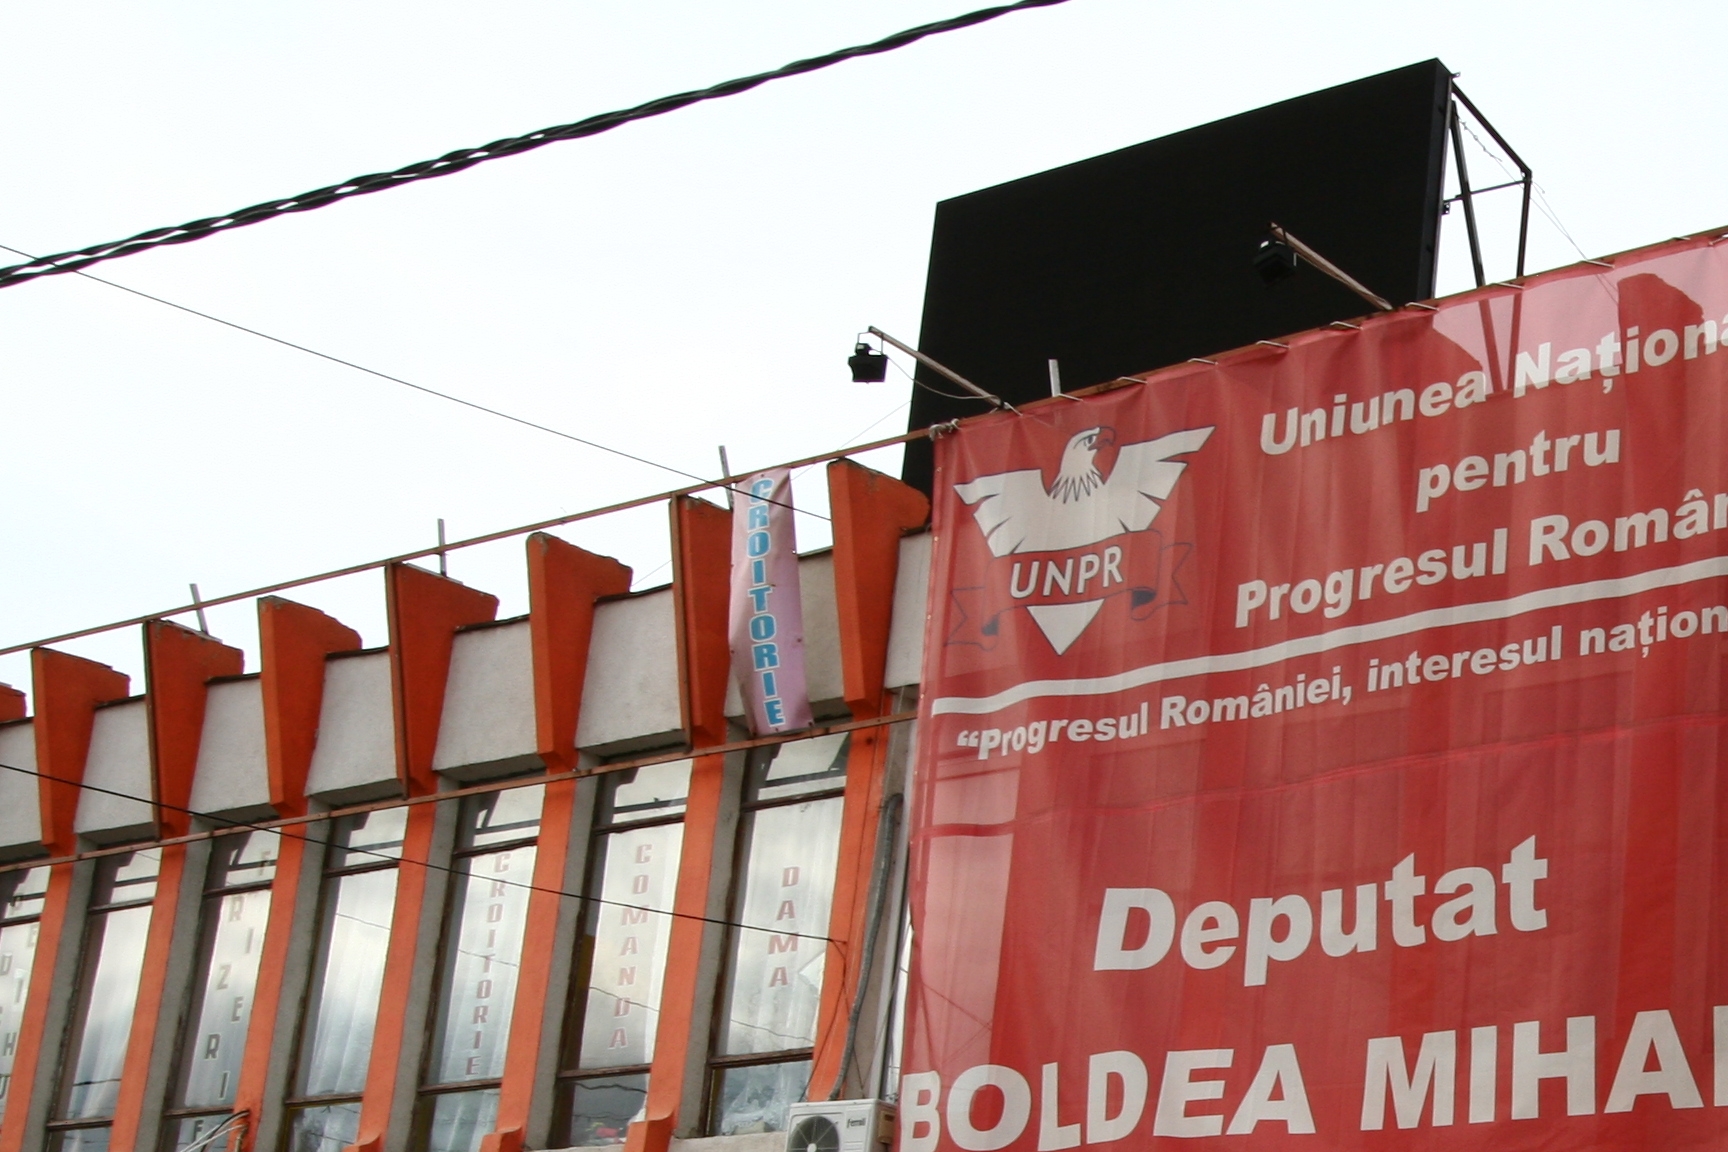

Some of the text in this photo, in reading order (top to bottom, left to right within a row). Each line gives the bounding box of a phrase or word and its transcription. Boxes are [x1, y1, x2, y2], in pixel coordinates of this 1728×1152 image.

[1259, 369, 1488, 456] Uniunea
[1416, 429, 1621, 513] pentru
[747, 478, 785, 727] CROITORIE
[1009, 545, 1124, 599] UNPR
[1236, 528, 1509, 628] Progresul
[1160, 666, 1353, 730] României,
[1367, 626, 1562, 692] interesul
[608, 843, 800, 1049] COMANDA DAMA
[1093, 836, 1548, 986] Deputat
[465, 852, 511, 1076] CROITORIE
